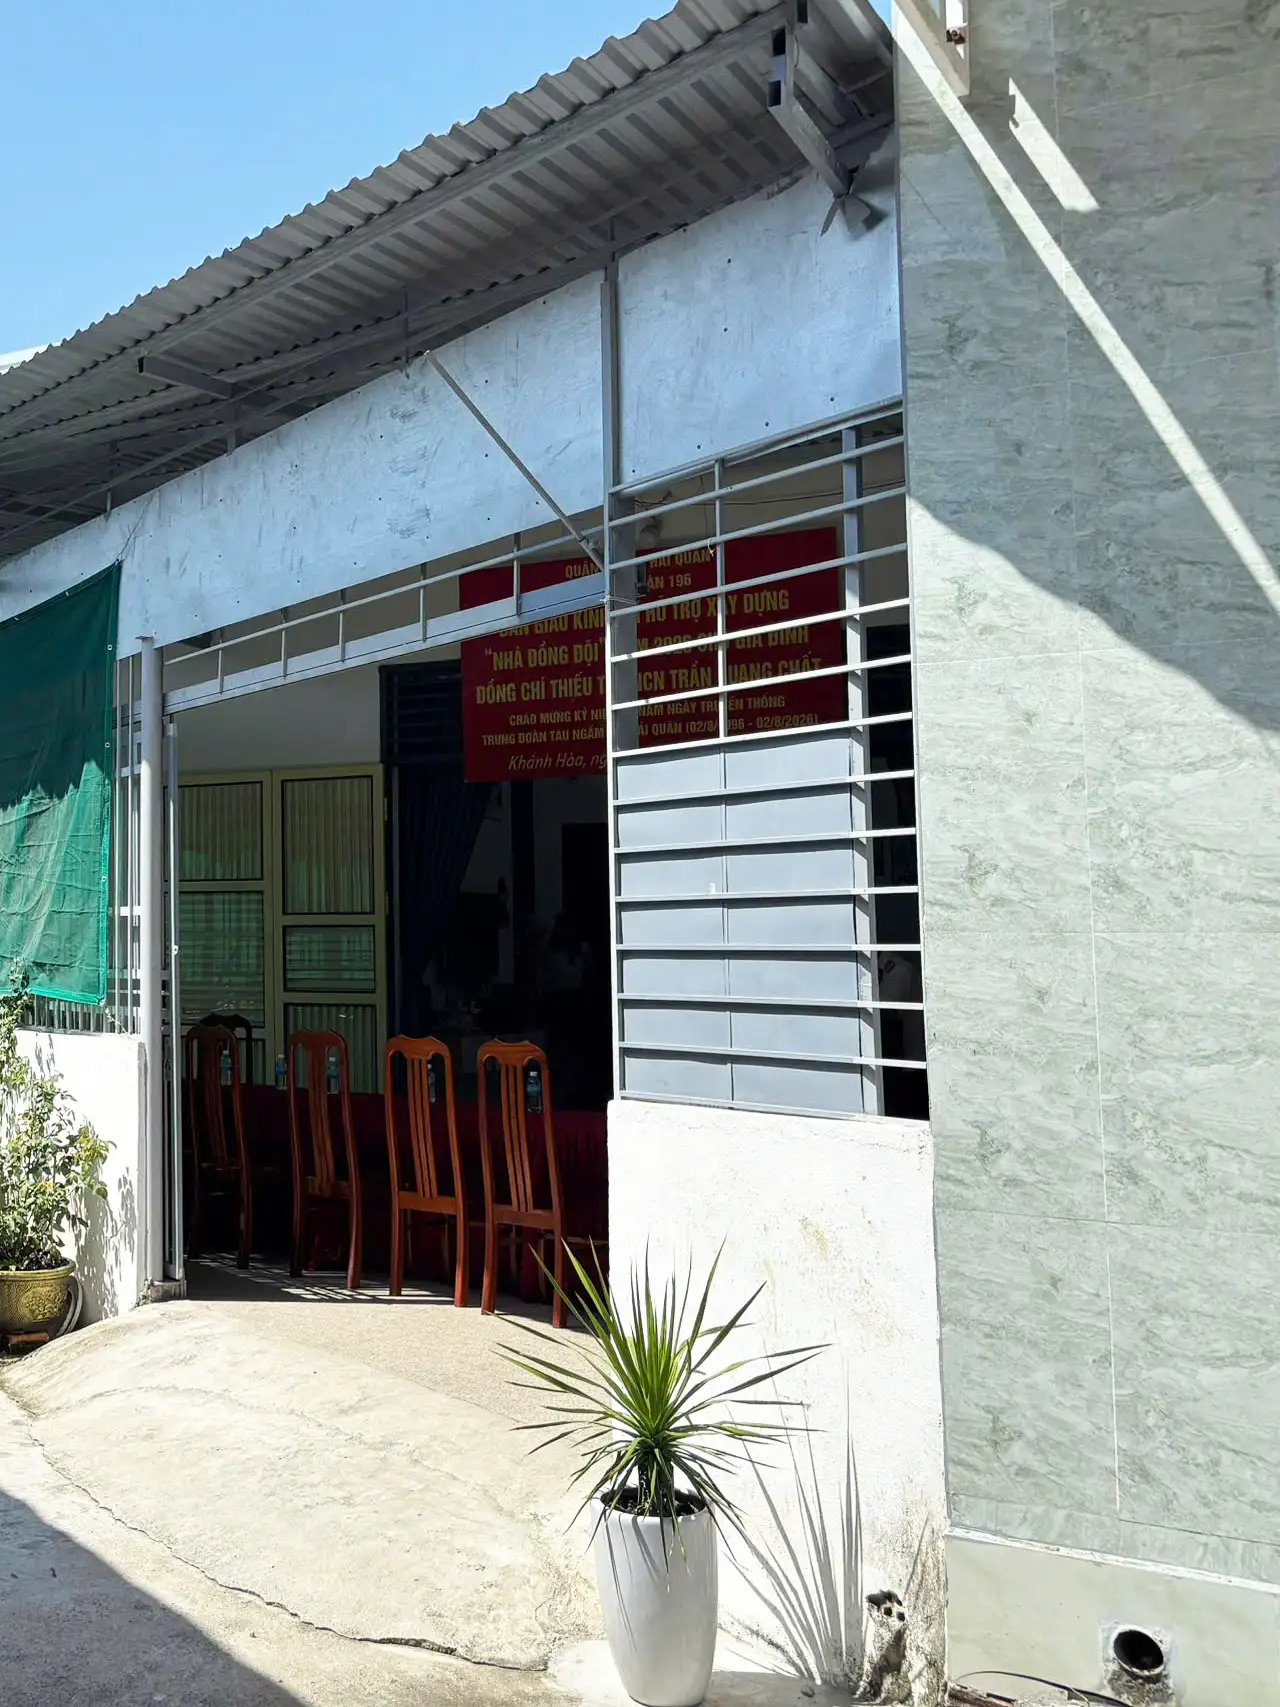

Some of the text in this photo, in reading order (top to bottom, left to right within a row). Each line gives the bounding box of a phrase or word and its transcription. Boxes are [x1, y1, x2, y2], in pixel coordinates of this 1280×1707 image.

[669, 573, 692, 587] 196
[706, 595, 738, 618] XY
[528, 640, 569, 668] ĐỒNG
[476, 678, 517, 704] ĐỒNG
[670, 660, 712, 689] TRẦN
[728, 660, 772, 685] UANG
